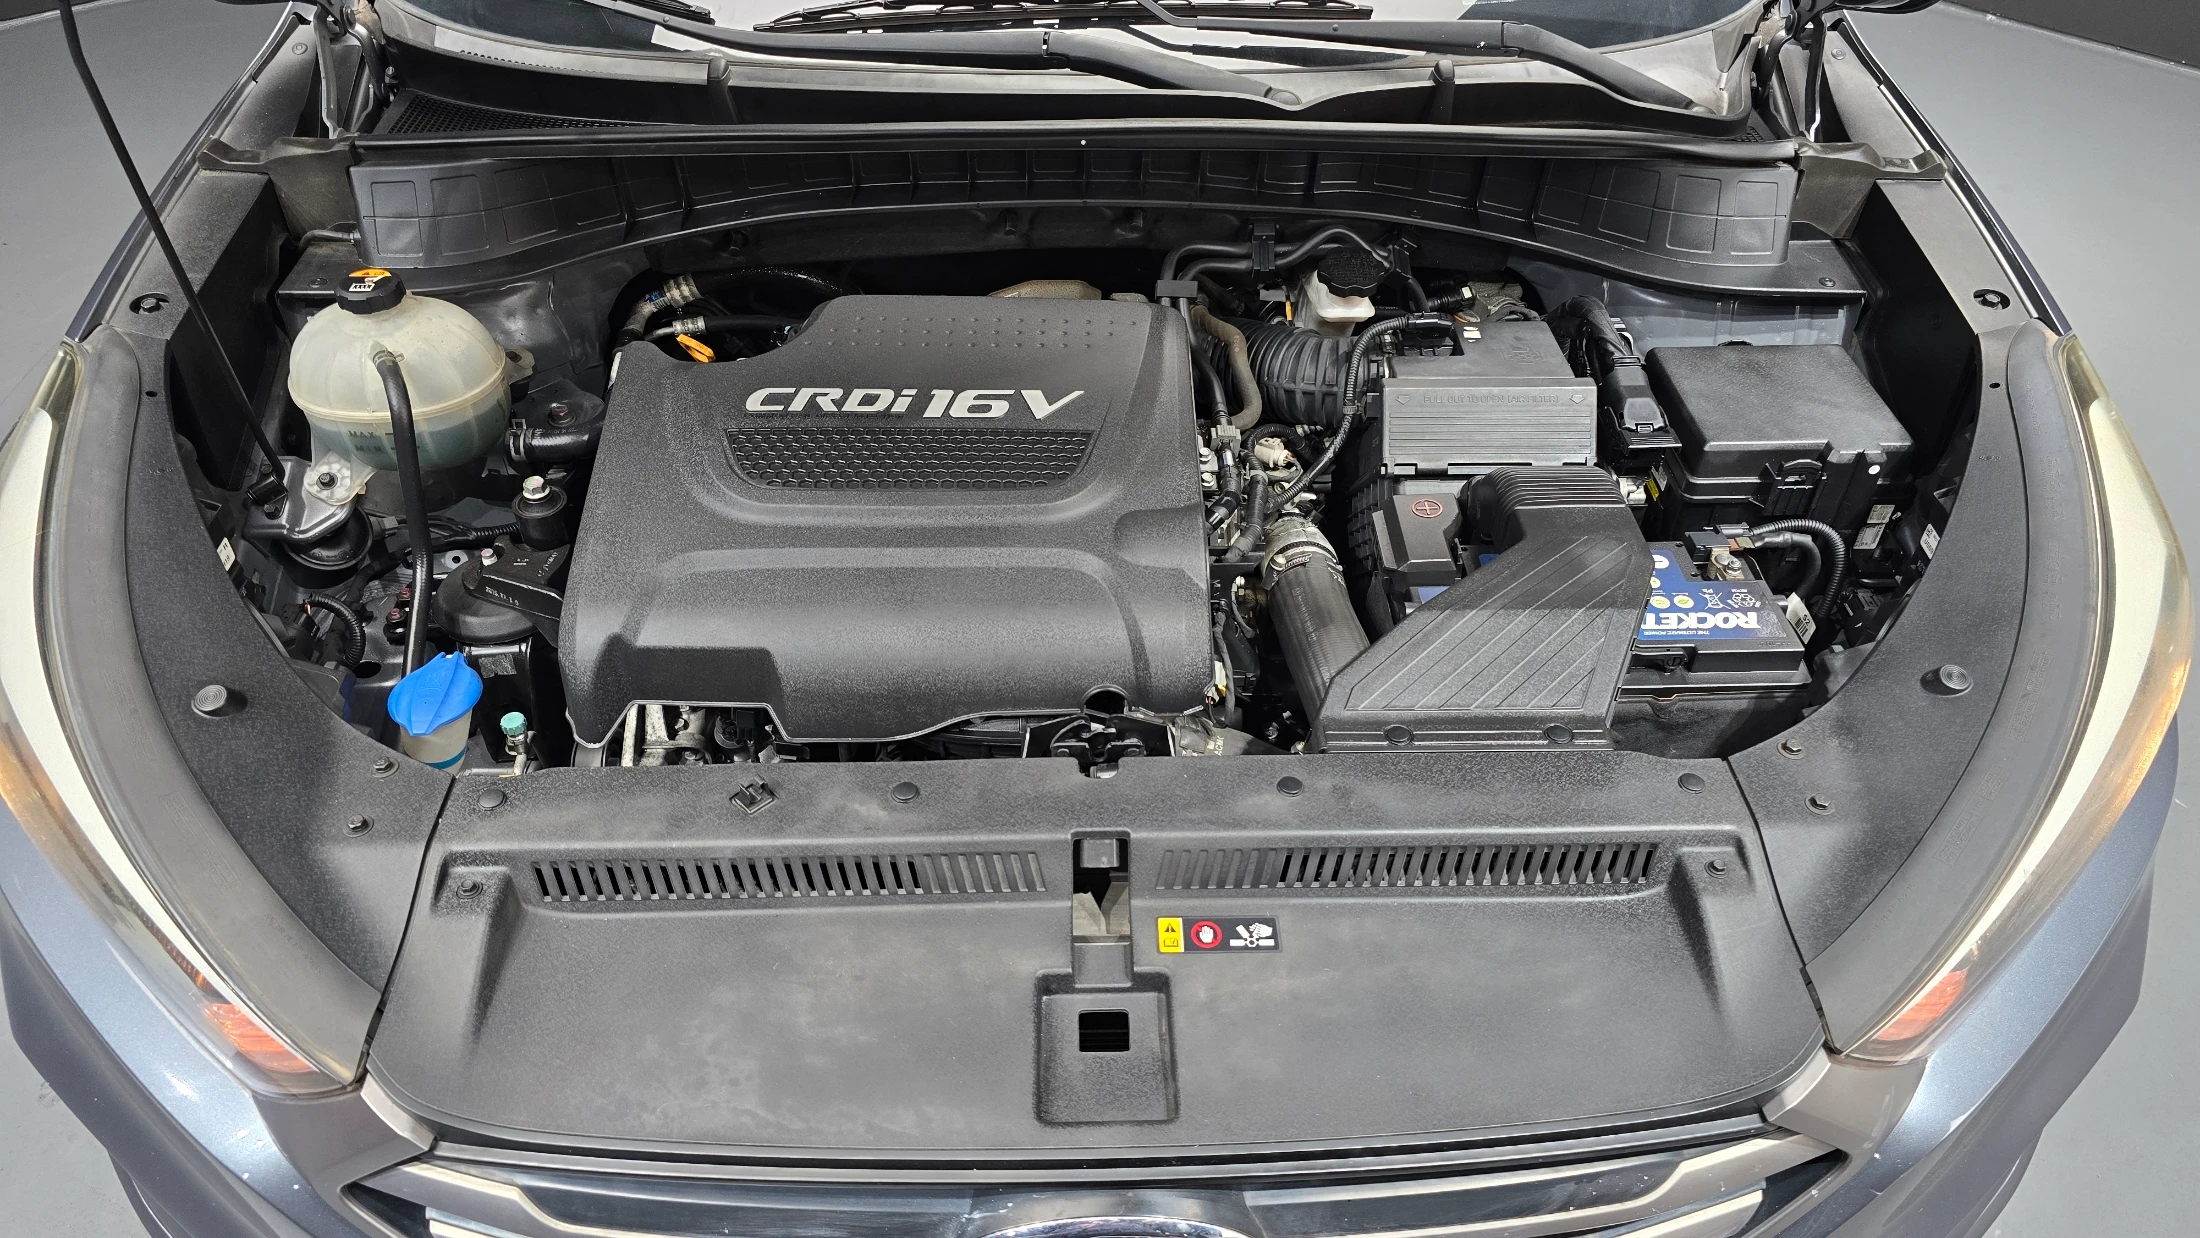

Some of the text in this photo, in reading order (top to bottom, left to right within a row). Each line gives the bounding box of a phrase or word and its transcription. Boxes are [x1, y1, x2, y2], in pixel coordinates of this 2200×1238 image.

[745, 387, 1086, 421] CRDi 16V
[1423, 395, 1445, 404] PULL
[1447, 395, 1465, 404] OUT
[1466, 395, 1479, 404] TO
[1480, 395, 1504, 404] OPEN
[1527, 394, 1559, 404] FILTER)
[348, 430, 375, 438] MAX
[354, 445, 382, 453] MIN
[1640, 611, 1761, 629] ROCKET
